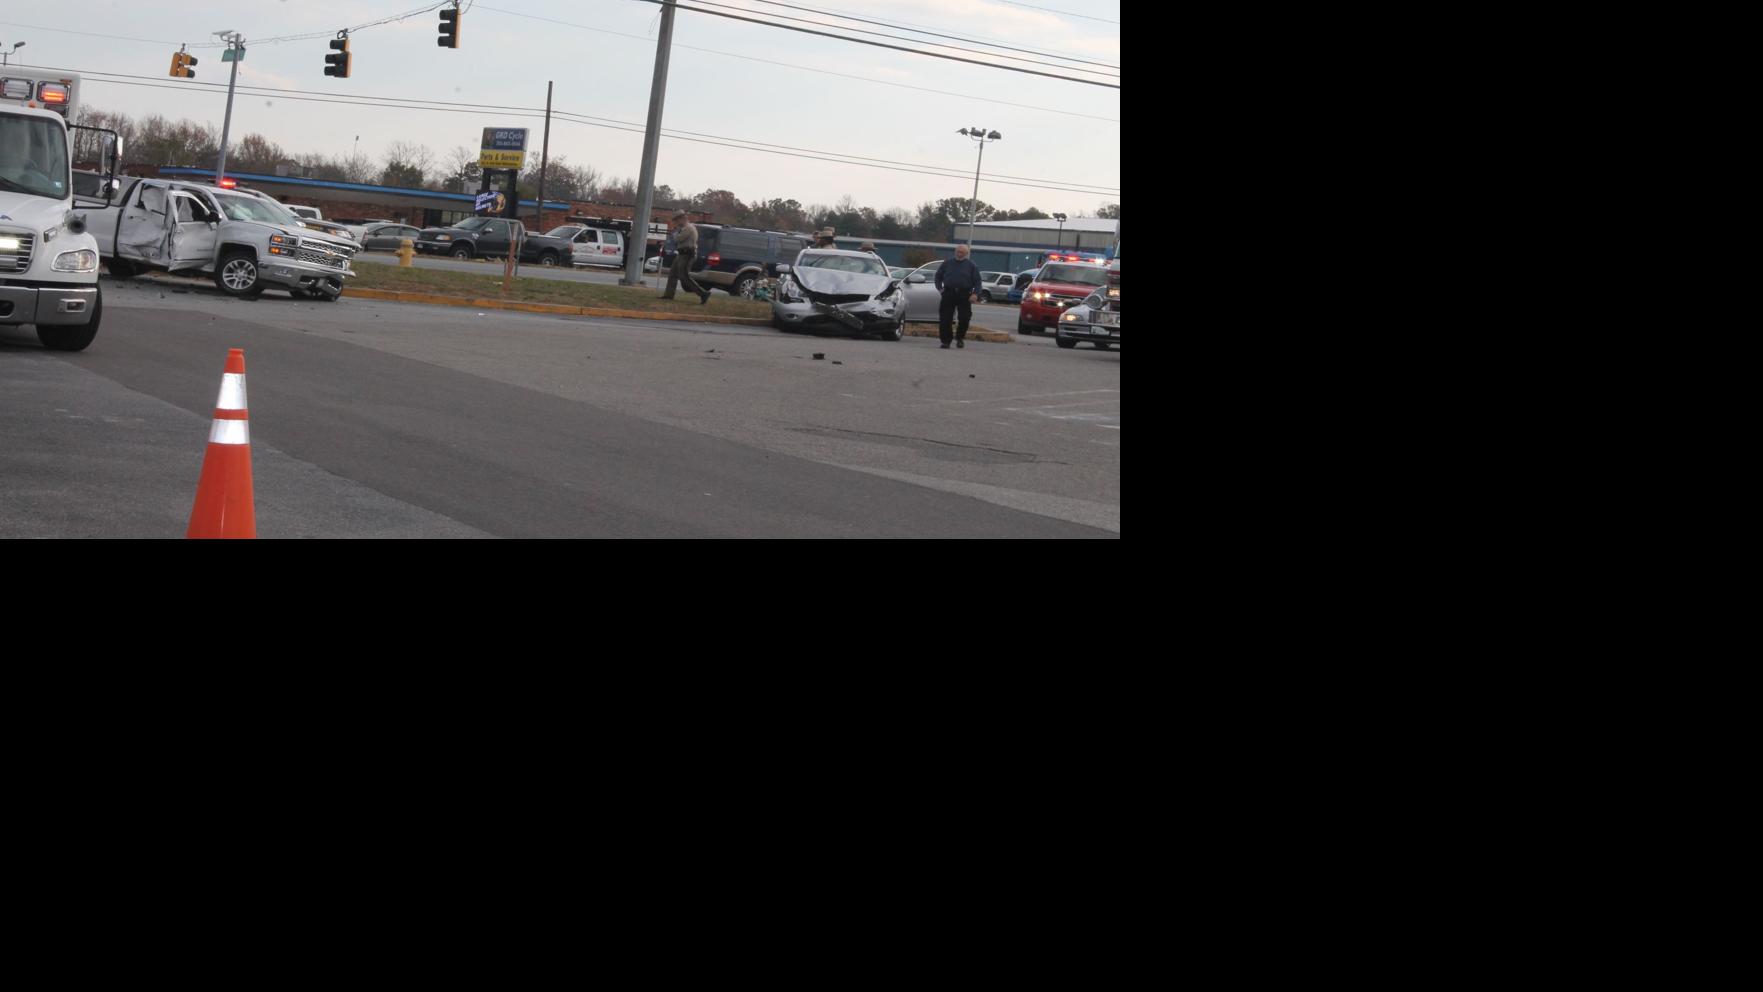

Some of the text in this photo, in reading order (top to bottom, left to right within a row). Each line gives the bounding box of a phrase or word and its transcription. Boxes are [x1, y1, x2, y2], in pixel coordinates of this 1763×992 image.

[508, 131, 524, 140] Cycle
[480, 152, 493, 160] Parts
[501, 153, 520, 161] Service
